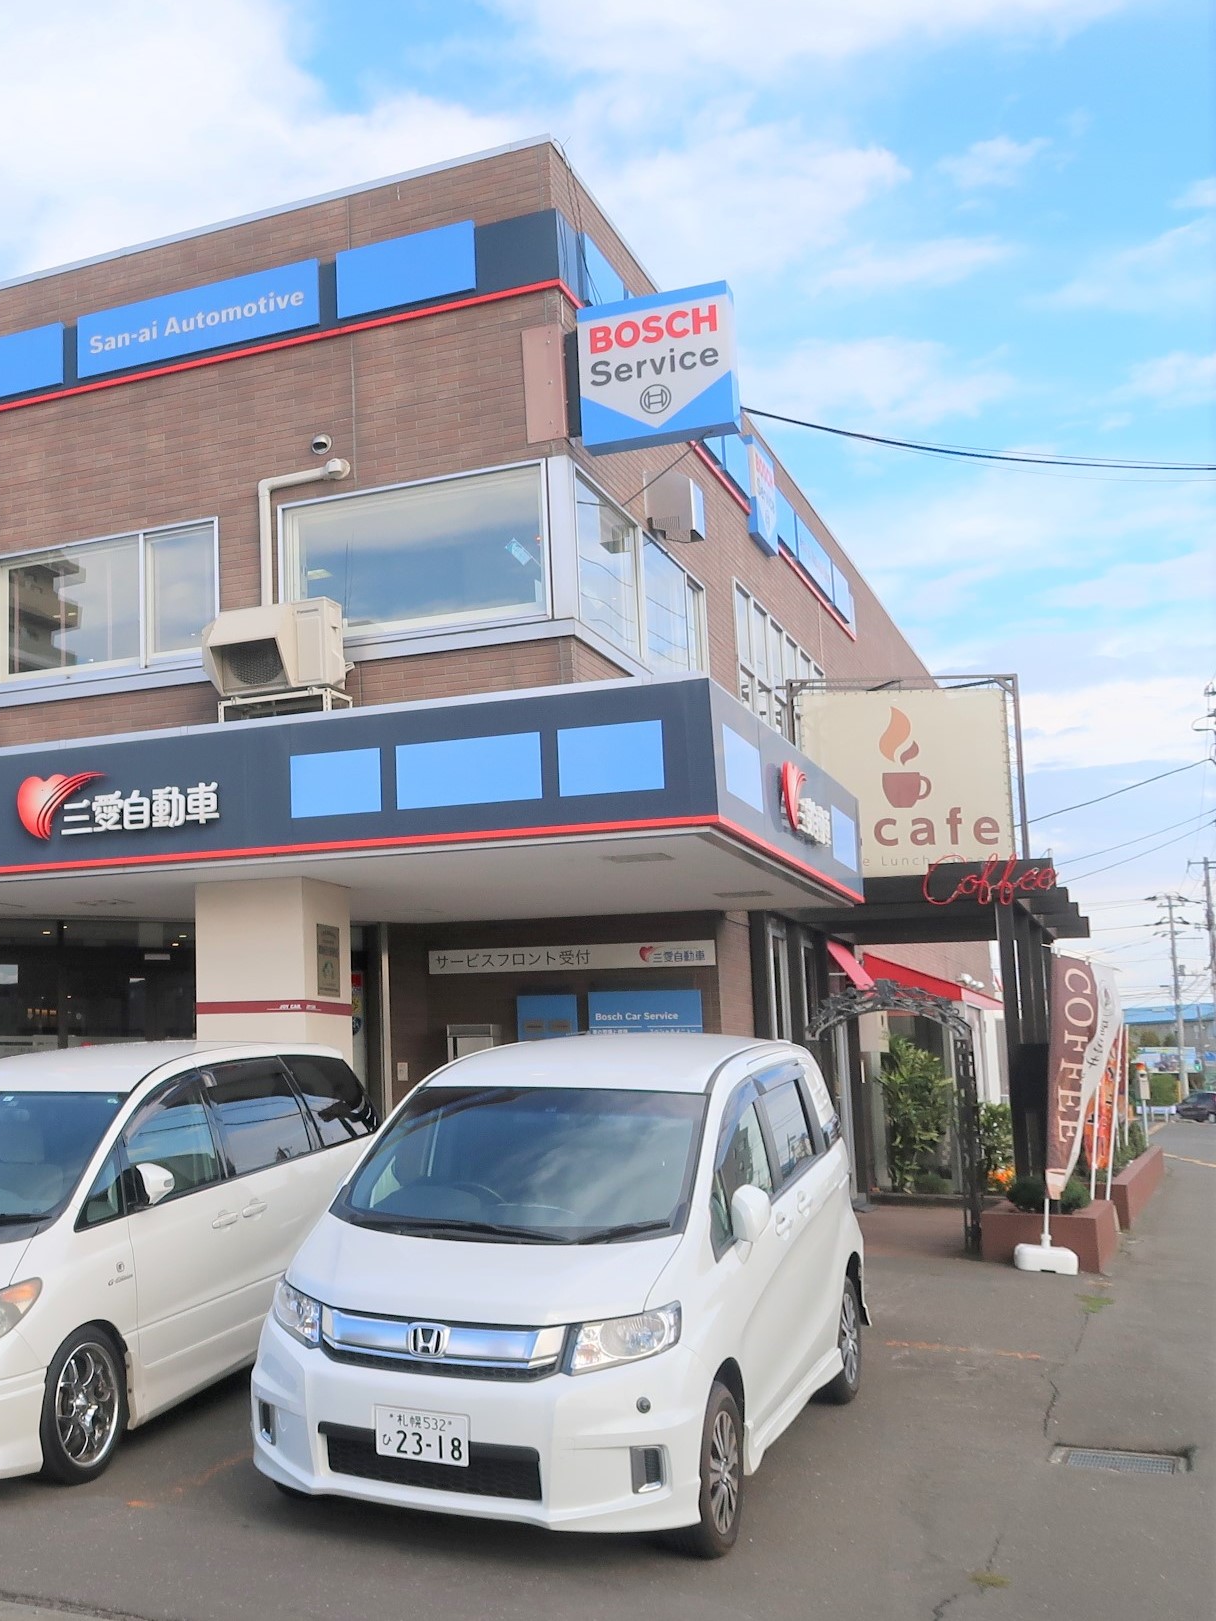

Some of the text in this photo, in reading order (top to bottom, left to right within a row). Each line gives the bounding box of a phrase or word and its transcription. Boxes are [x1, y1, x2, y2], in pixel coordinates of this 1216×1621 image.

[89, 290, 305, 354] San-ai Automotive
[589, 304, 718, 354] BOSCH
[590, 347, 719, 387] Service
[61, 782, 220, 835] 三愛自動車
[873, 807, 1000, 846] cafe
[923, 853, 1059, 905] Coffee
[436, 949, 590, 969] サービスフロント受付
[595, 1011, 678, 1021] Bosch Car Service
[396, 1430, 462, 1461] 23-18
